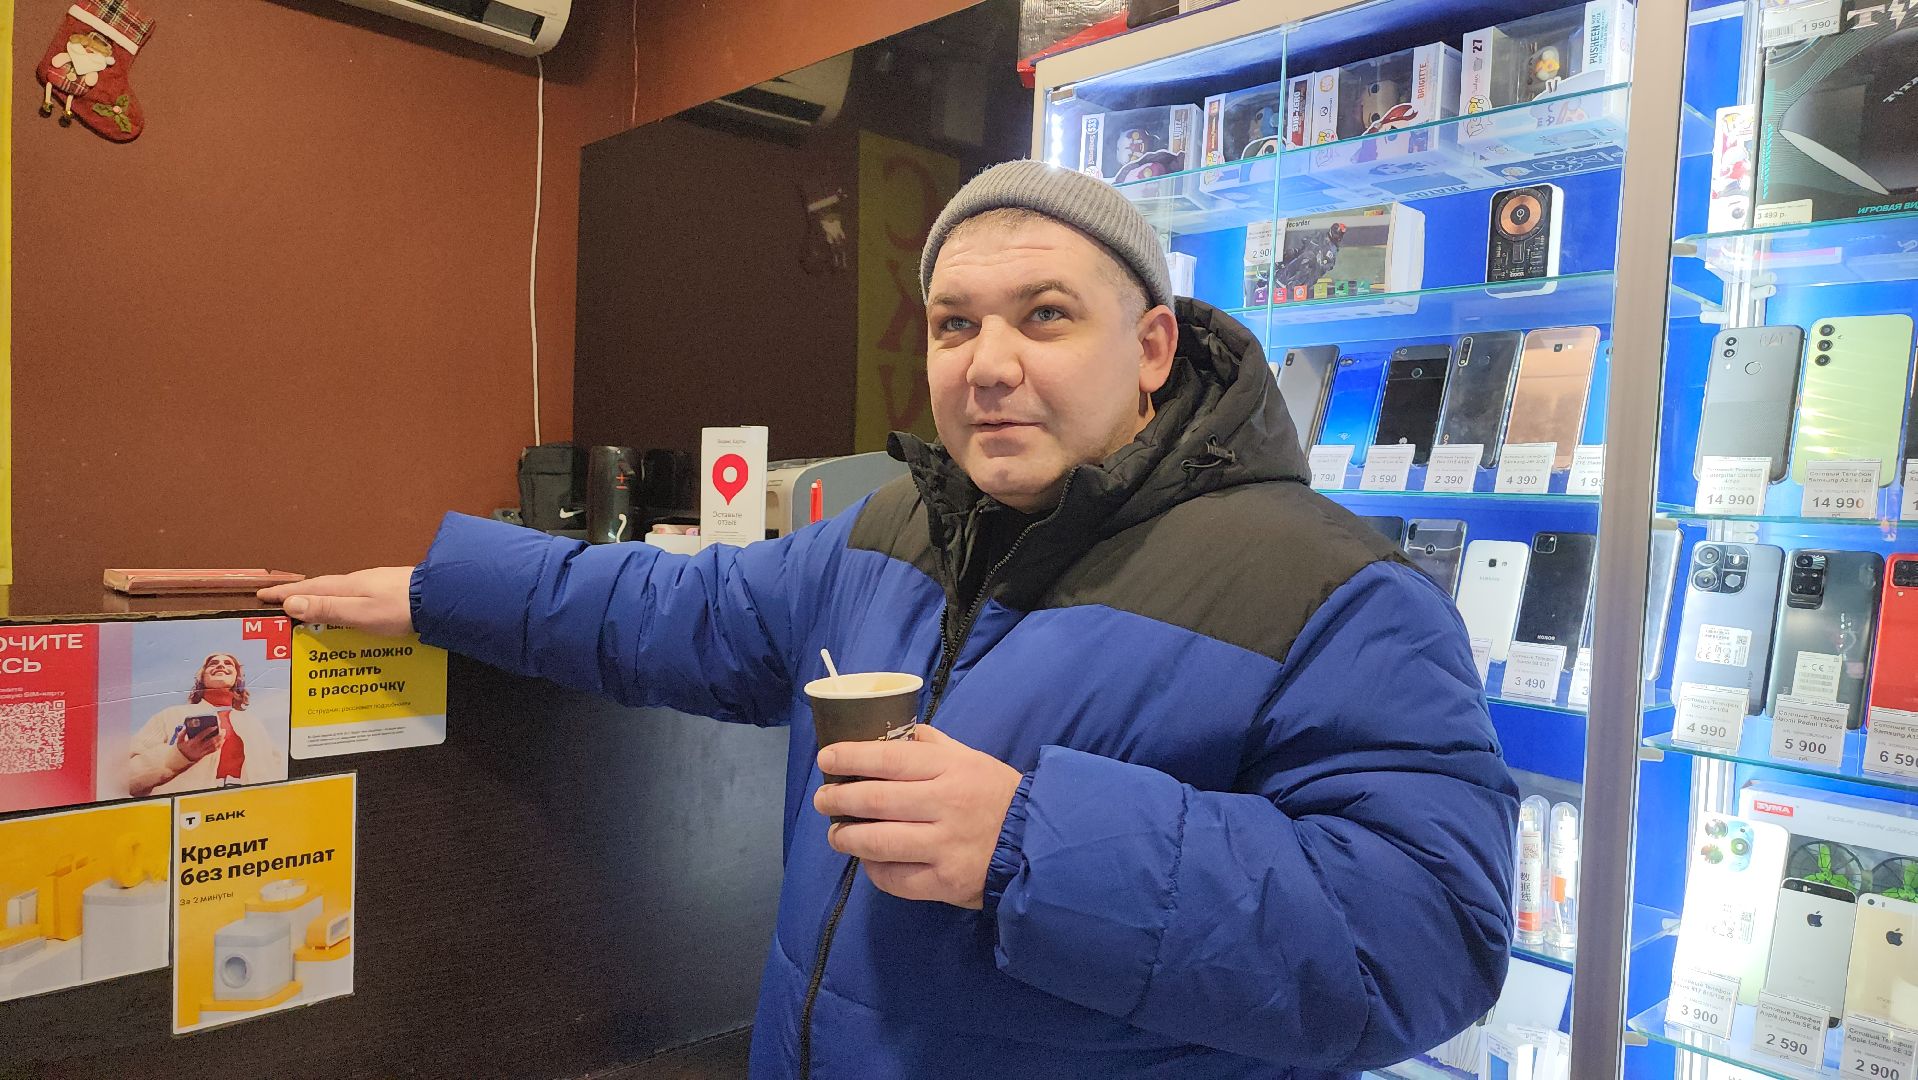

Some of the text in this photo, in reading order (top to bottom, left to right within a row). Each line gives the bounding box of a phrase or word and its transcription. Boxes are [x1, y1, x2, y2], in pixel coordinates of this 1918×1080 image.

[1811, 20, 1831, 31] 990
[1417, 62, 1428, 99] BRIGITTE
[1292, 91, 1301, 132] SUB-ZERO
[1857, 202, 1903, 215] ИГРОВАЯ
[1370, 474, 1397, 483] 3 590
[1434, 475, 1463, 484] 2 390
[1506, 475, 1537, 485] 4 390
[1707, 494, 1755, 505] 14 990
[1812, 497, 1865, 508] 14 990
[308, 646, 413, 663] Здесь можно
[0, 657, 42, 674] СЬ
[308, 665, 382, 680] оплатить
[308, 680, 406, 699] в рассрочку
[1514, 676, 1546, 690] 3 490
[1686, 722, 1727, 738] 4 990
[1784, 738, 1827, 755] 5 900
[1880, 750, 1889, 763] 6
[205, 809, 246, 823] БАНК
[181, 837, 269, 864] Кредит
[180, 848, 335, 886] без переплат
[179, 891, 235, 906] За 2 минуты
[1681, 1004, 1718, 1025] 3 900
[1766, 1033, 1808, 1056] 2 590
[1855, 1058, 1900, 1080] 2 900
